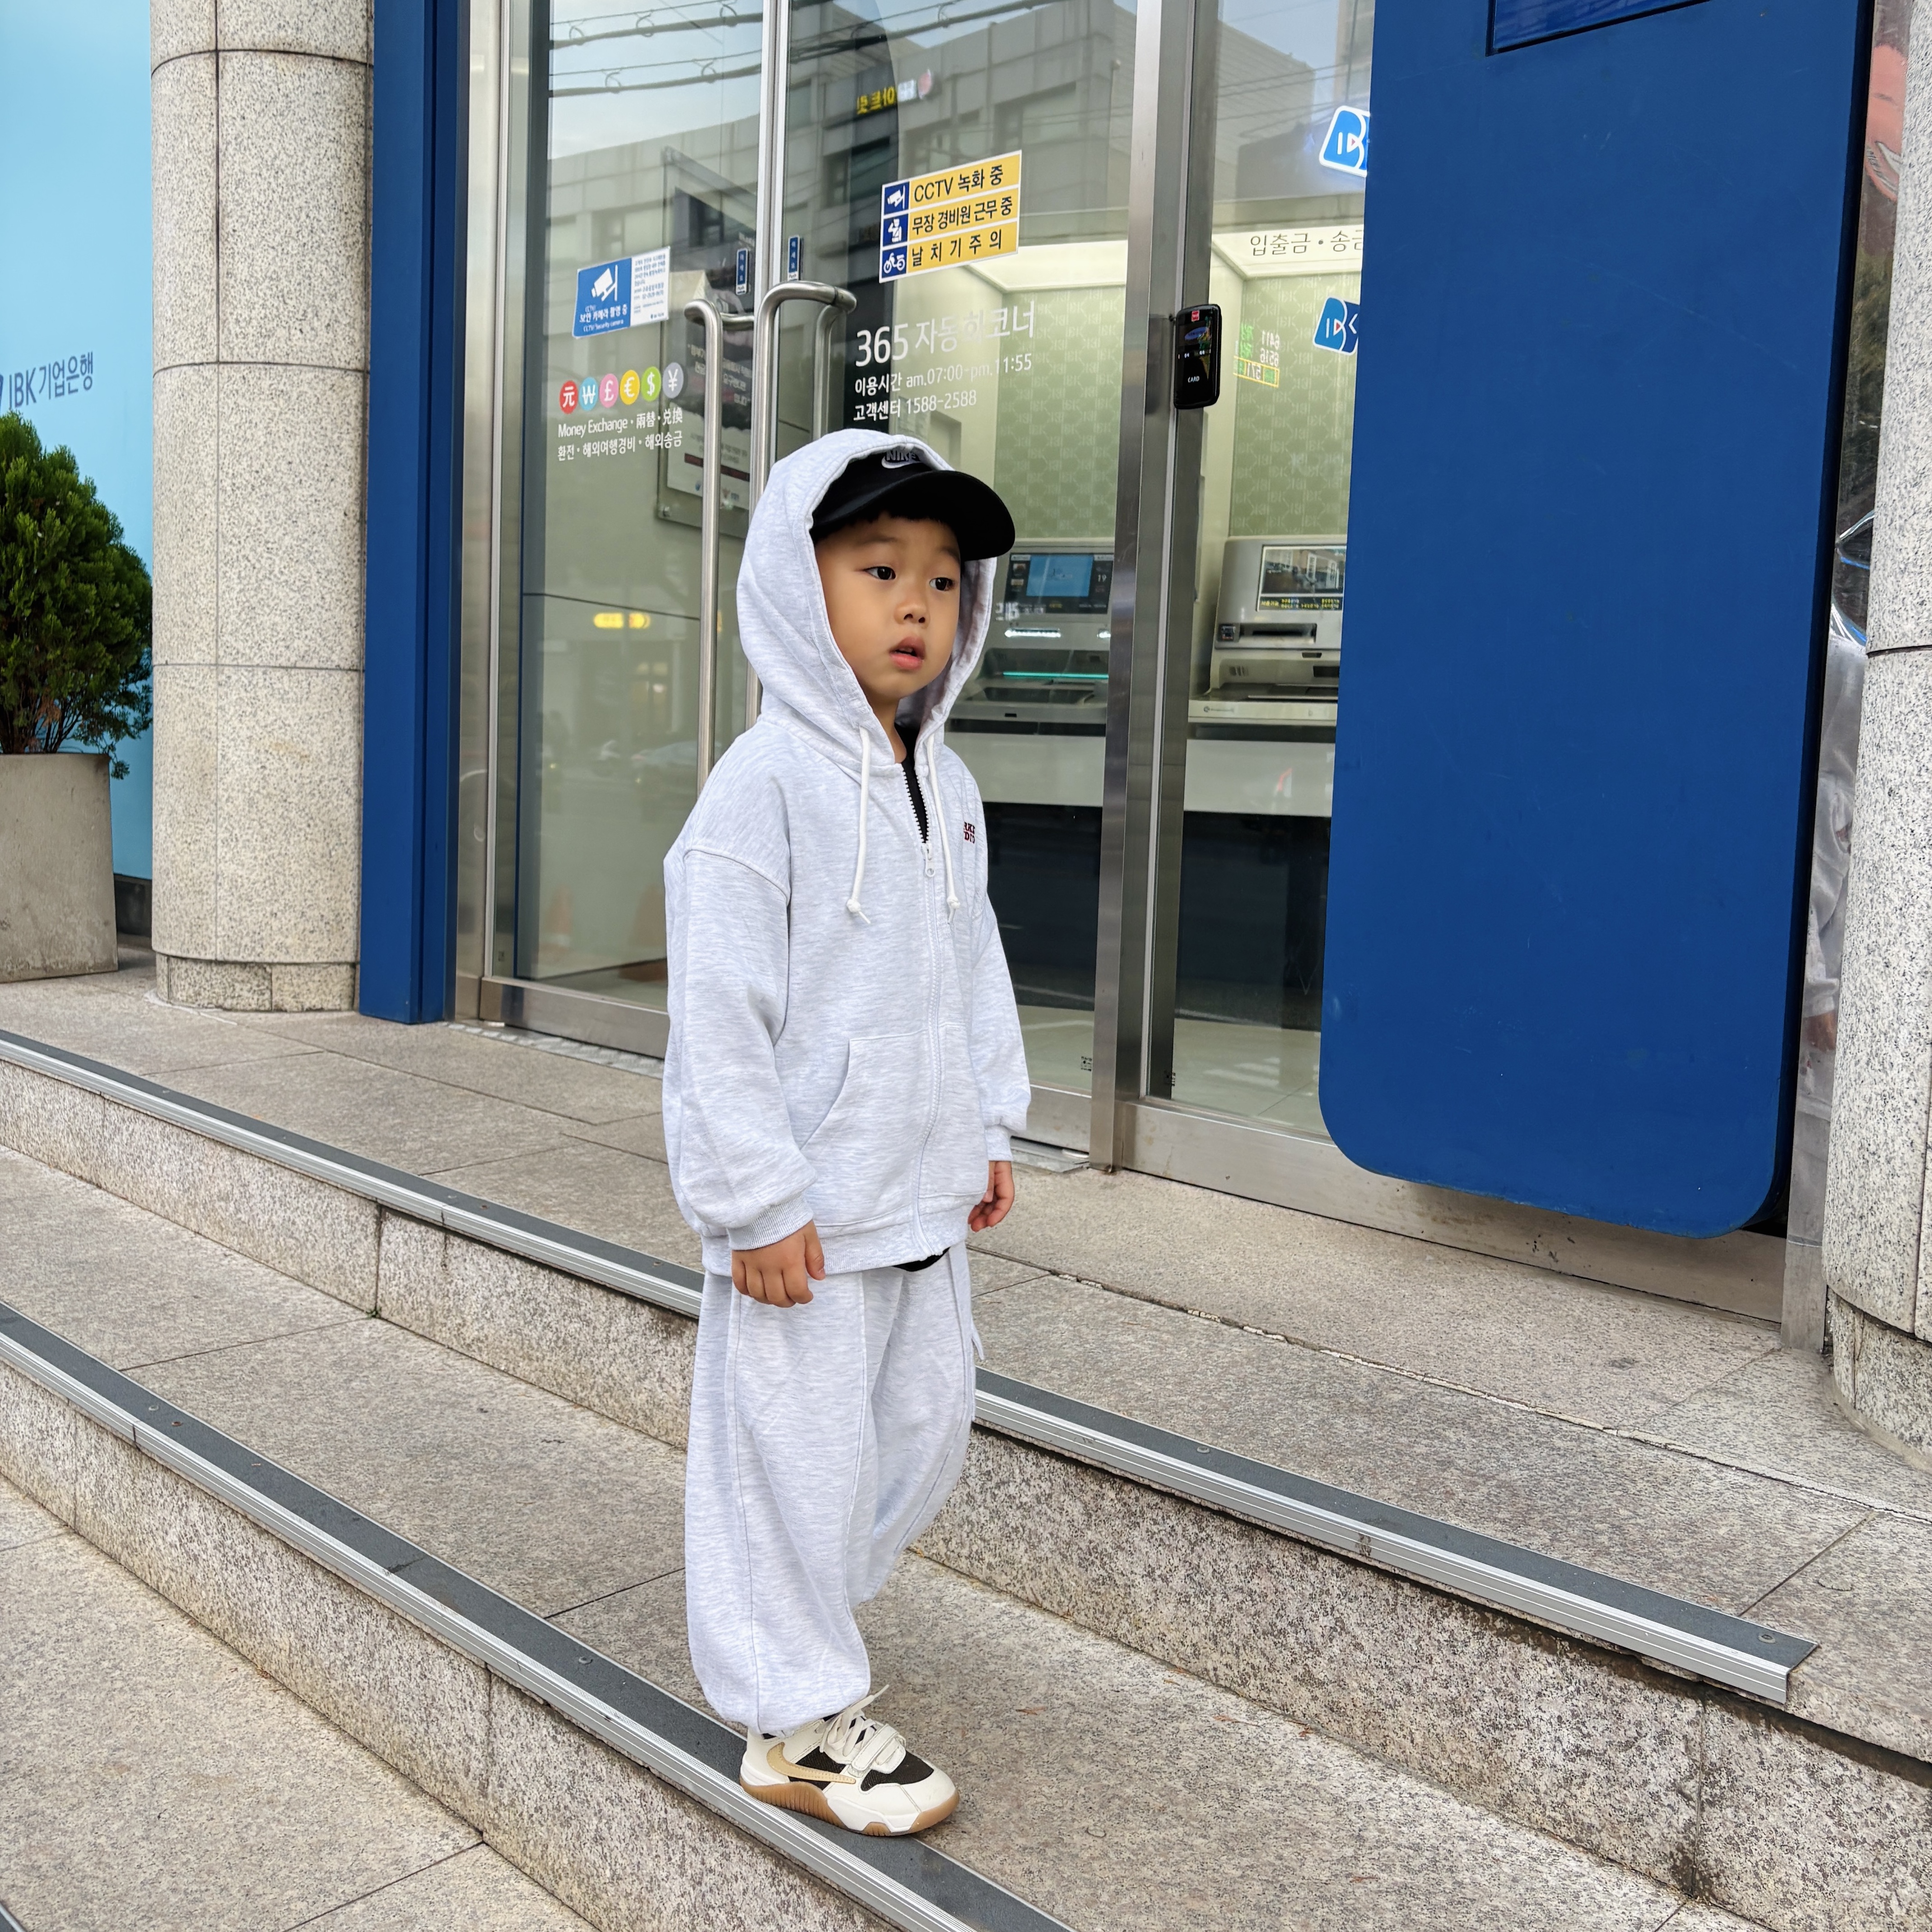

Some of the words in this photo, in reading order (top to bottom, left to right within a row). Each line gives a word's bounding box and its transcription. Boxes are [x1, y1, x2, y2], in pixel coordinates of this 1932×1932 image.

[914, 177, 954, 202] CCTV
[958, 168, 985, 192] 녹화
[990, 164, 1003, 186] 중
[912, 213, 935, 235] 무장
[938, 205, 971, 230] 경비원
[974, 200, 997, 222] 근무
[1001, 196, 1013, 216] 중
[1250, 233, 1311, 256] 입출금
[856, 323, 908, 367] 365
[855, 372, 902, 396] 이용시간
[853, 398, 900, 421] 고객센터
[906, 390, 977, 414] 1588-2588
[558, 424, 586, 438] Money
[588, 418, 628, 433] Exchange
[886, 450, 916, 461] NIKE
